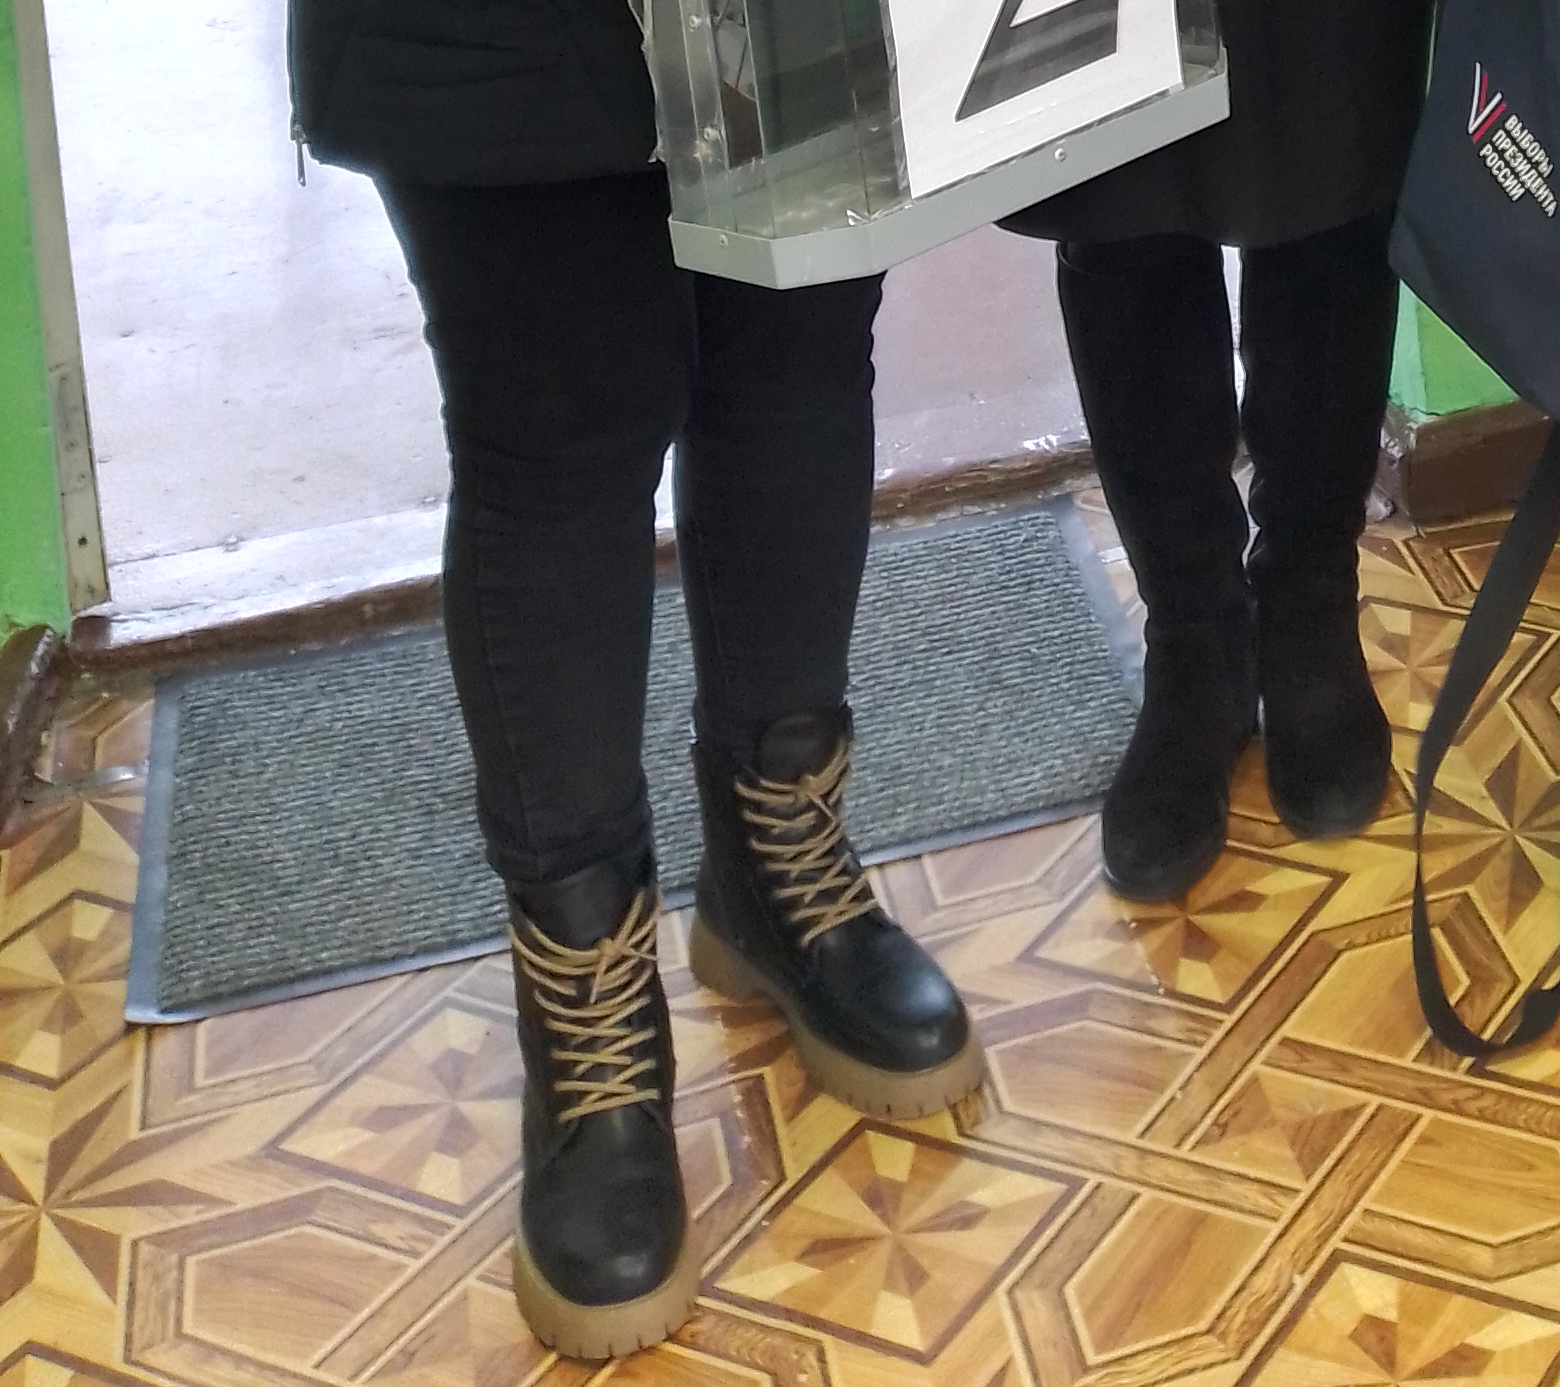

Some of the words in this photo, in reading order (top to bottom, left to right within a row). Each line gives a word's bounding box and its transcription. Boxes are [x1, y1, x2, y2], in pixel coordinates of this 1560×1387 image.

[1479, 142, 1526, 202] РОССИИ
[1491, 128, 1559, 219] ПРЕЗИДЕНТА
[1503, 113, 1555, 179] ВЫБОРЫ
